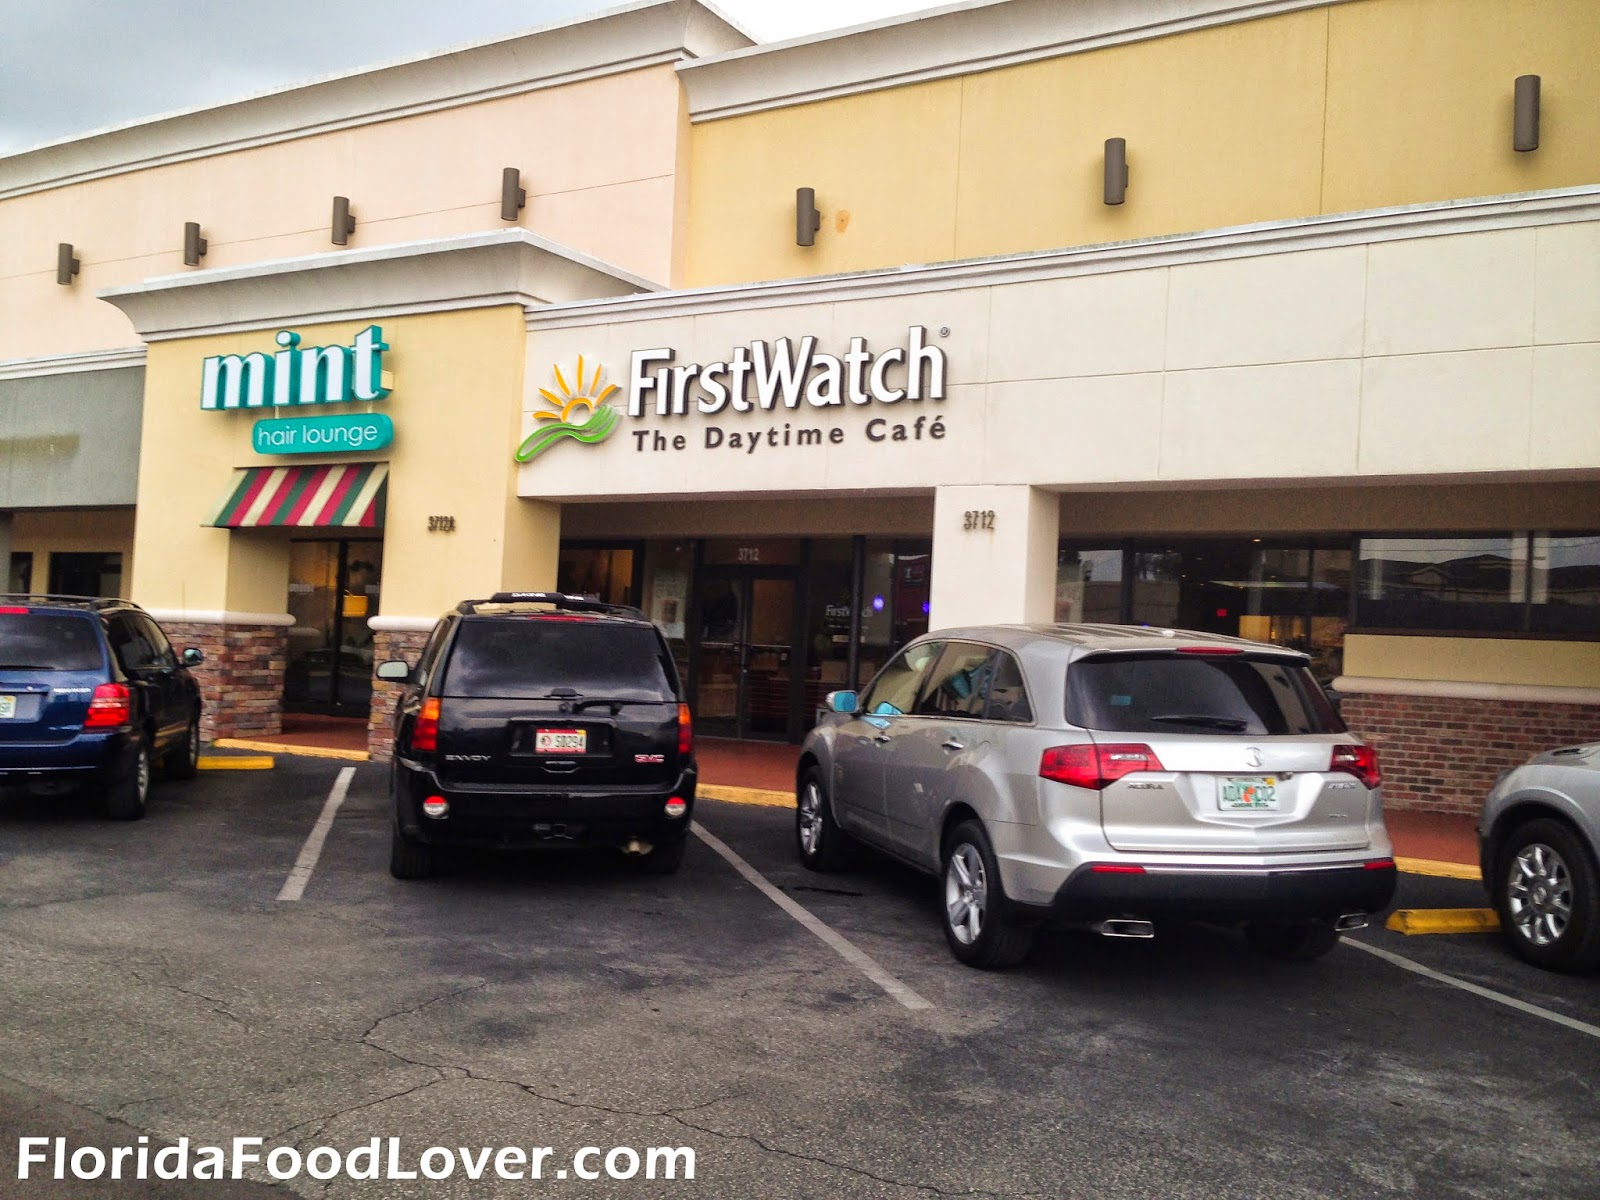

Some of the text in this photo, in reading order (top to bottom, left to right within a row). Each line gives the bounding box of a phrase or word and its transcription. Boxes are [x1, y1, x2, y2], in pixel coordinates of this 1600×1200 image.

[201, 325, 389, 410] mint
[258, 425, 378, 447] hair lounge
[633, 416, 947, 454] The Daytime Café
[963, 510, 995, 530] 3712
